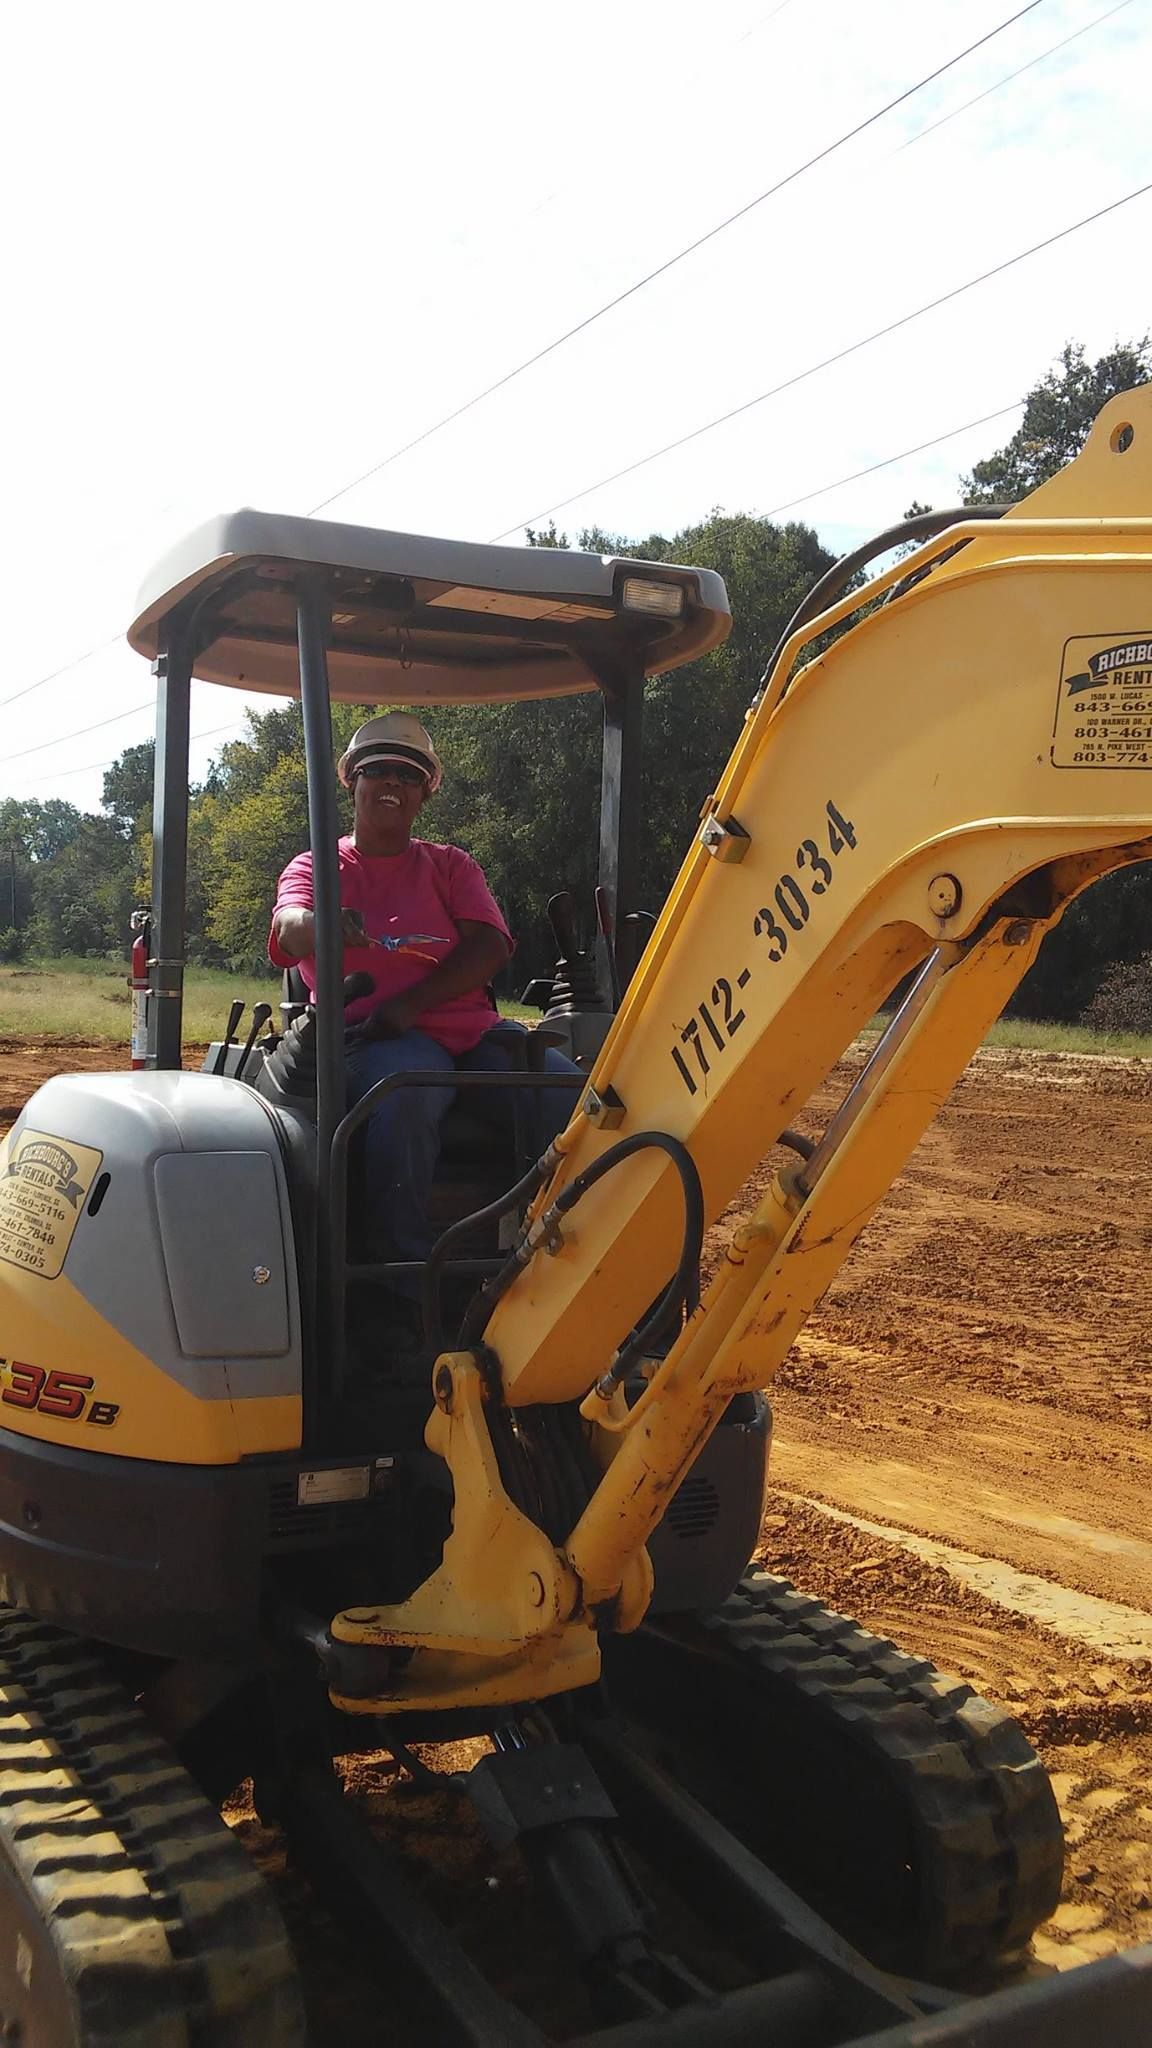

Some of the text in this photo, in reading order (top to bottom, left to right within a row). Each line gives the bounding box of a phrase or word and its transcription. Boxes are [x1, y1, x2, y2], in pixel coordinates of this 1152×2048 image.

[1113, 671, 1152, 685] RENT
[1121, 692, 1143, 700] LUCAS
[1101, 718, 1130, 726] WARNER
[1107, 743, 1122, 751] PIKE
[1126, 743, 1145, 751] WEST
[21, 1164, 56, 1188] RENTALS
